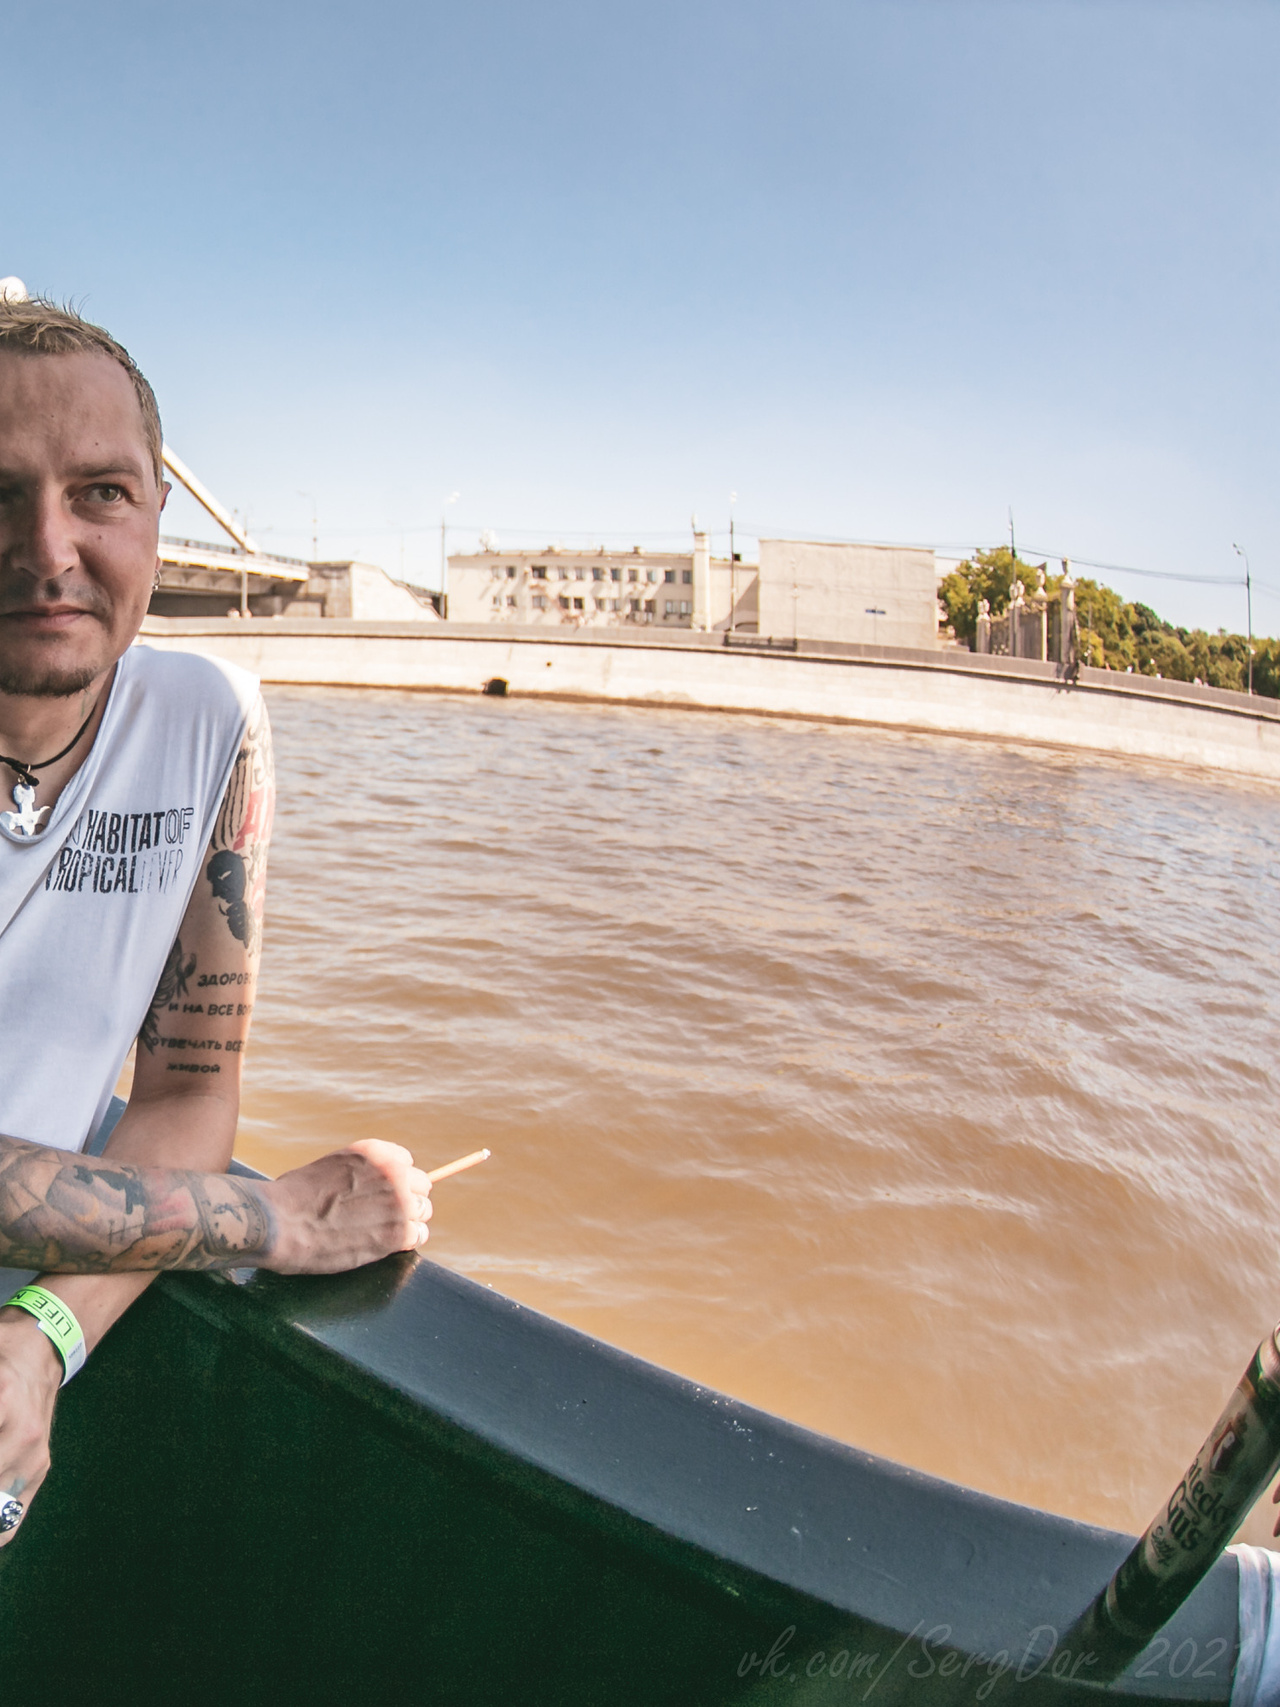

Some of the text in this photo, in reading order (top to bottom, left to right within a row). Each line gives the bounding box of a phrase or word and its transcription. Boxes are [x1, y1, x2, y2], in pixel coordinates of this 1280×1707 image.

[82, 809, 165, 855] HABITAT
[164, 807, 195, 844] OF
[168, 1003, 179, 1013] И
[183, 1003, 204, 1014] НА
[207, 1003, 234, 1016] ВСЕ
[32, 1296, 73, 1337] LIFE
